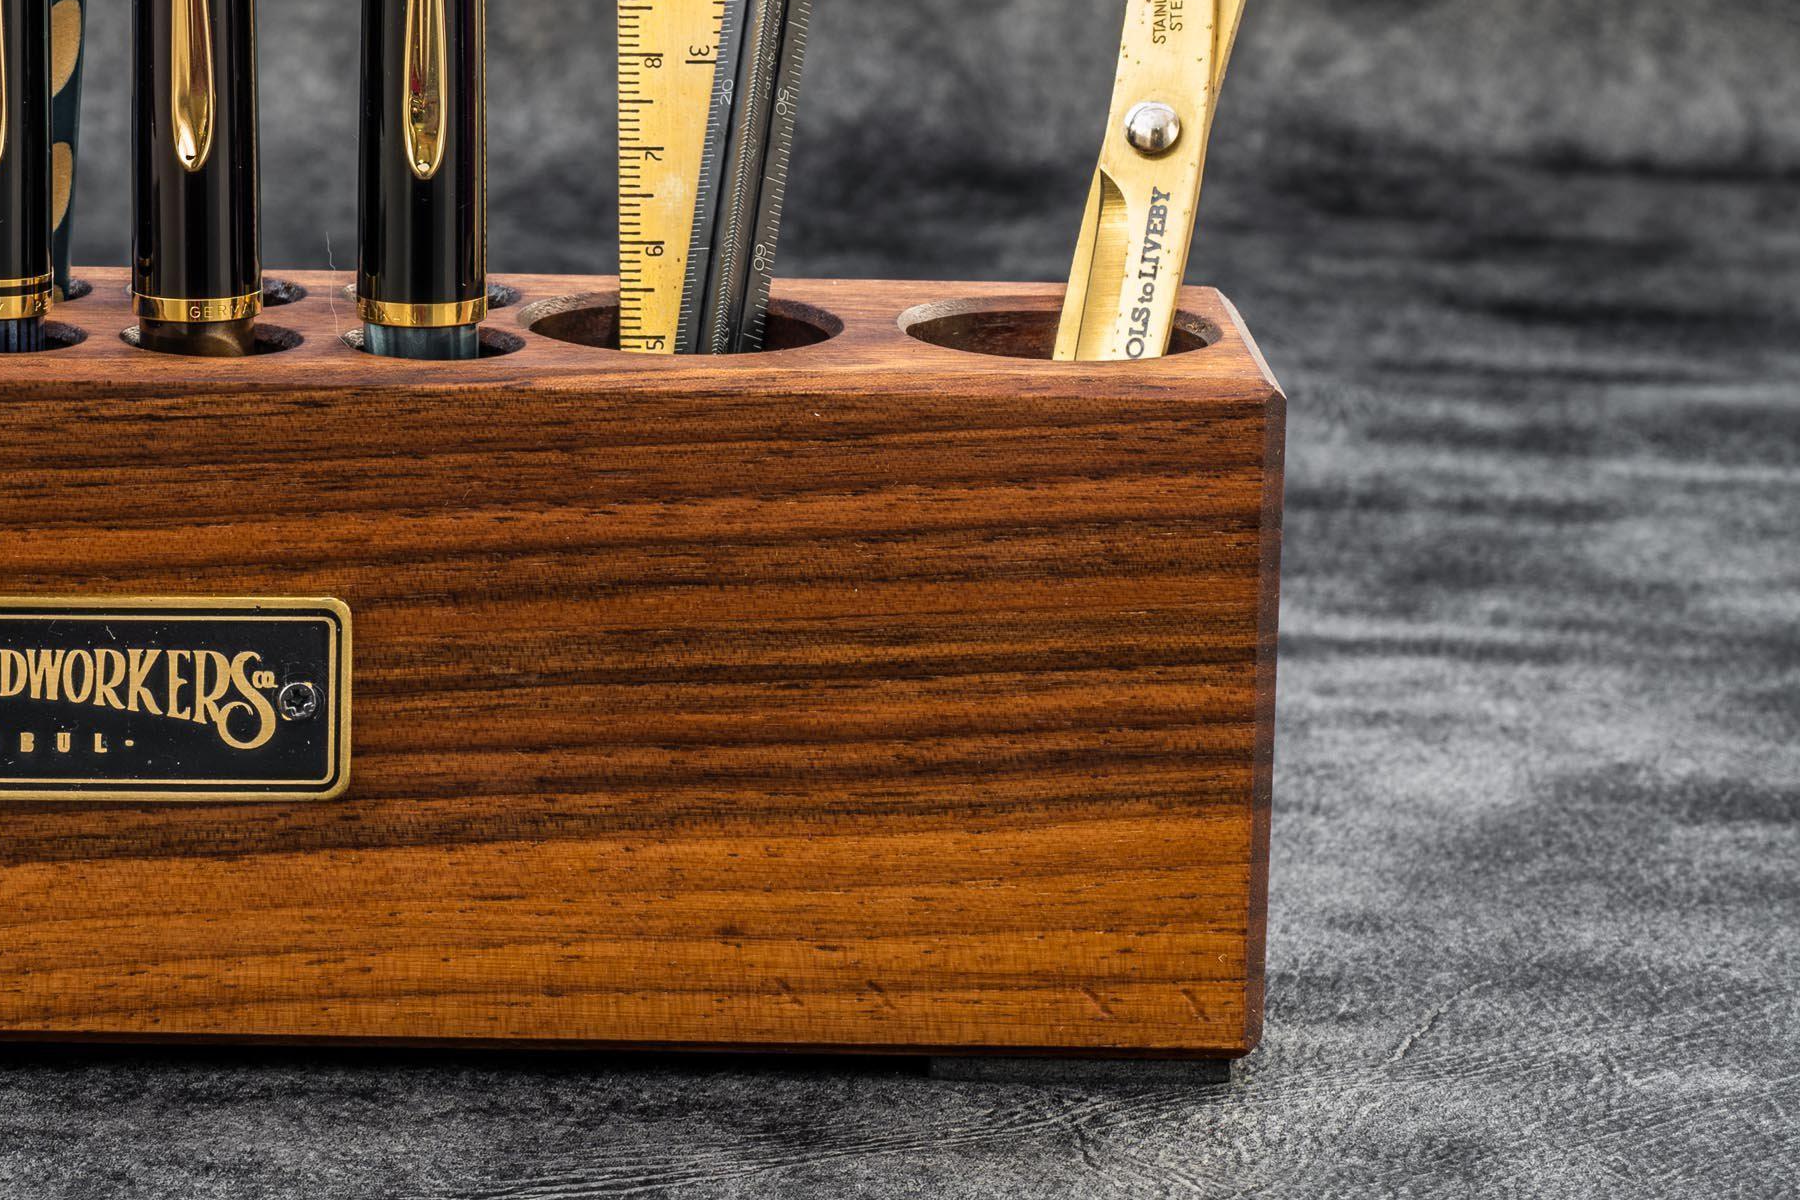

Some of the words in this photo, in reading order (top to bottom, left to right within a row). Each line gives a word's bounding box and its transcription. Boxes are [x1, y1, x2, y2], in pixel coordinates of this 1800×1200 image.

[689, 44, 710, 57] 3
[644, 56, 663, 69] 8
[644, 150, 663, 161] 7
[645, 245, 664, 257] 6
[1137, 282, 1155, 304] to
[646, 339, 665, 351] 5
